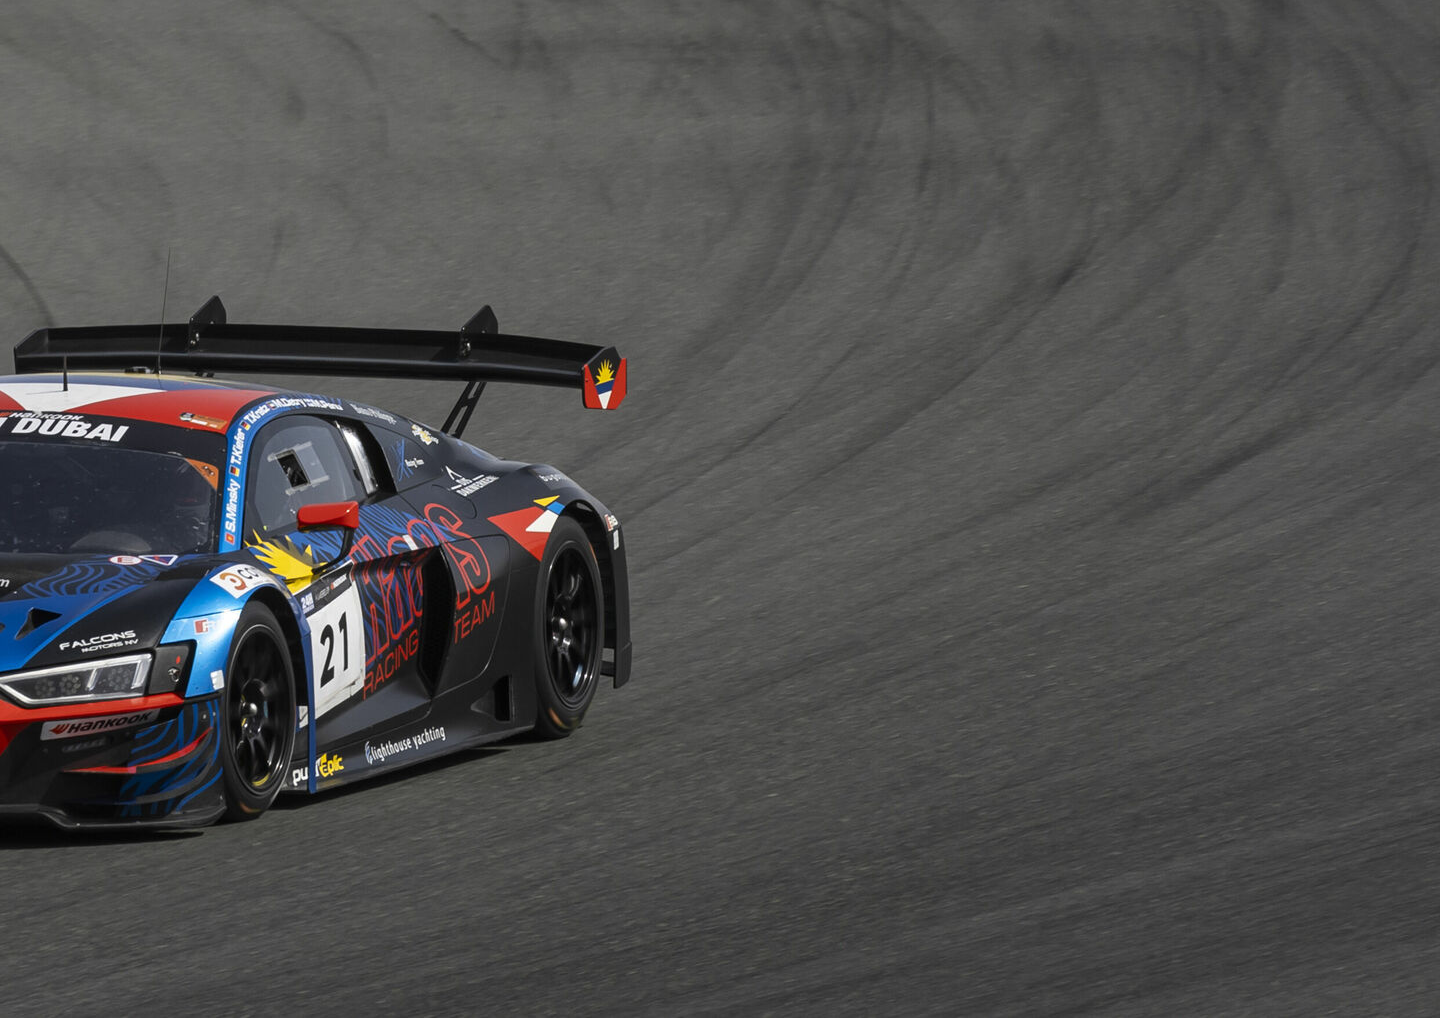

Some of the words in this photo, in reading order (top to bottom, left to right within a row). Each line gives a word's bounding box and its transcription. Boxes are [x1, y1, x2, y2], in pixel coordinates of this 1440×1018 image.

[11, 417, 130, 442] DUBAI
[224, 479, 241, 533] S.Minsky
[59, 630, 136, 650] FALCONS
[81, 641, 124, 653] MOTORS
[320, 611, 348, 688] 21
[363, 629, 419, 700] RACING
[454, 591, 495, 644] TEAM
[371, 737, 412, 762] lighthouse
[413, 726, 446, 750] yachting
